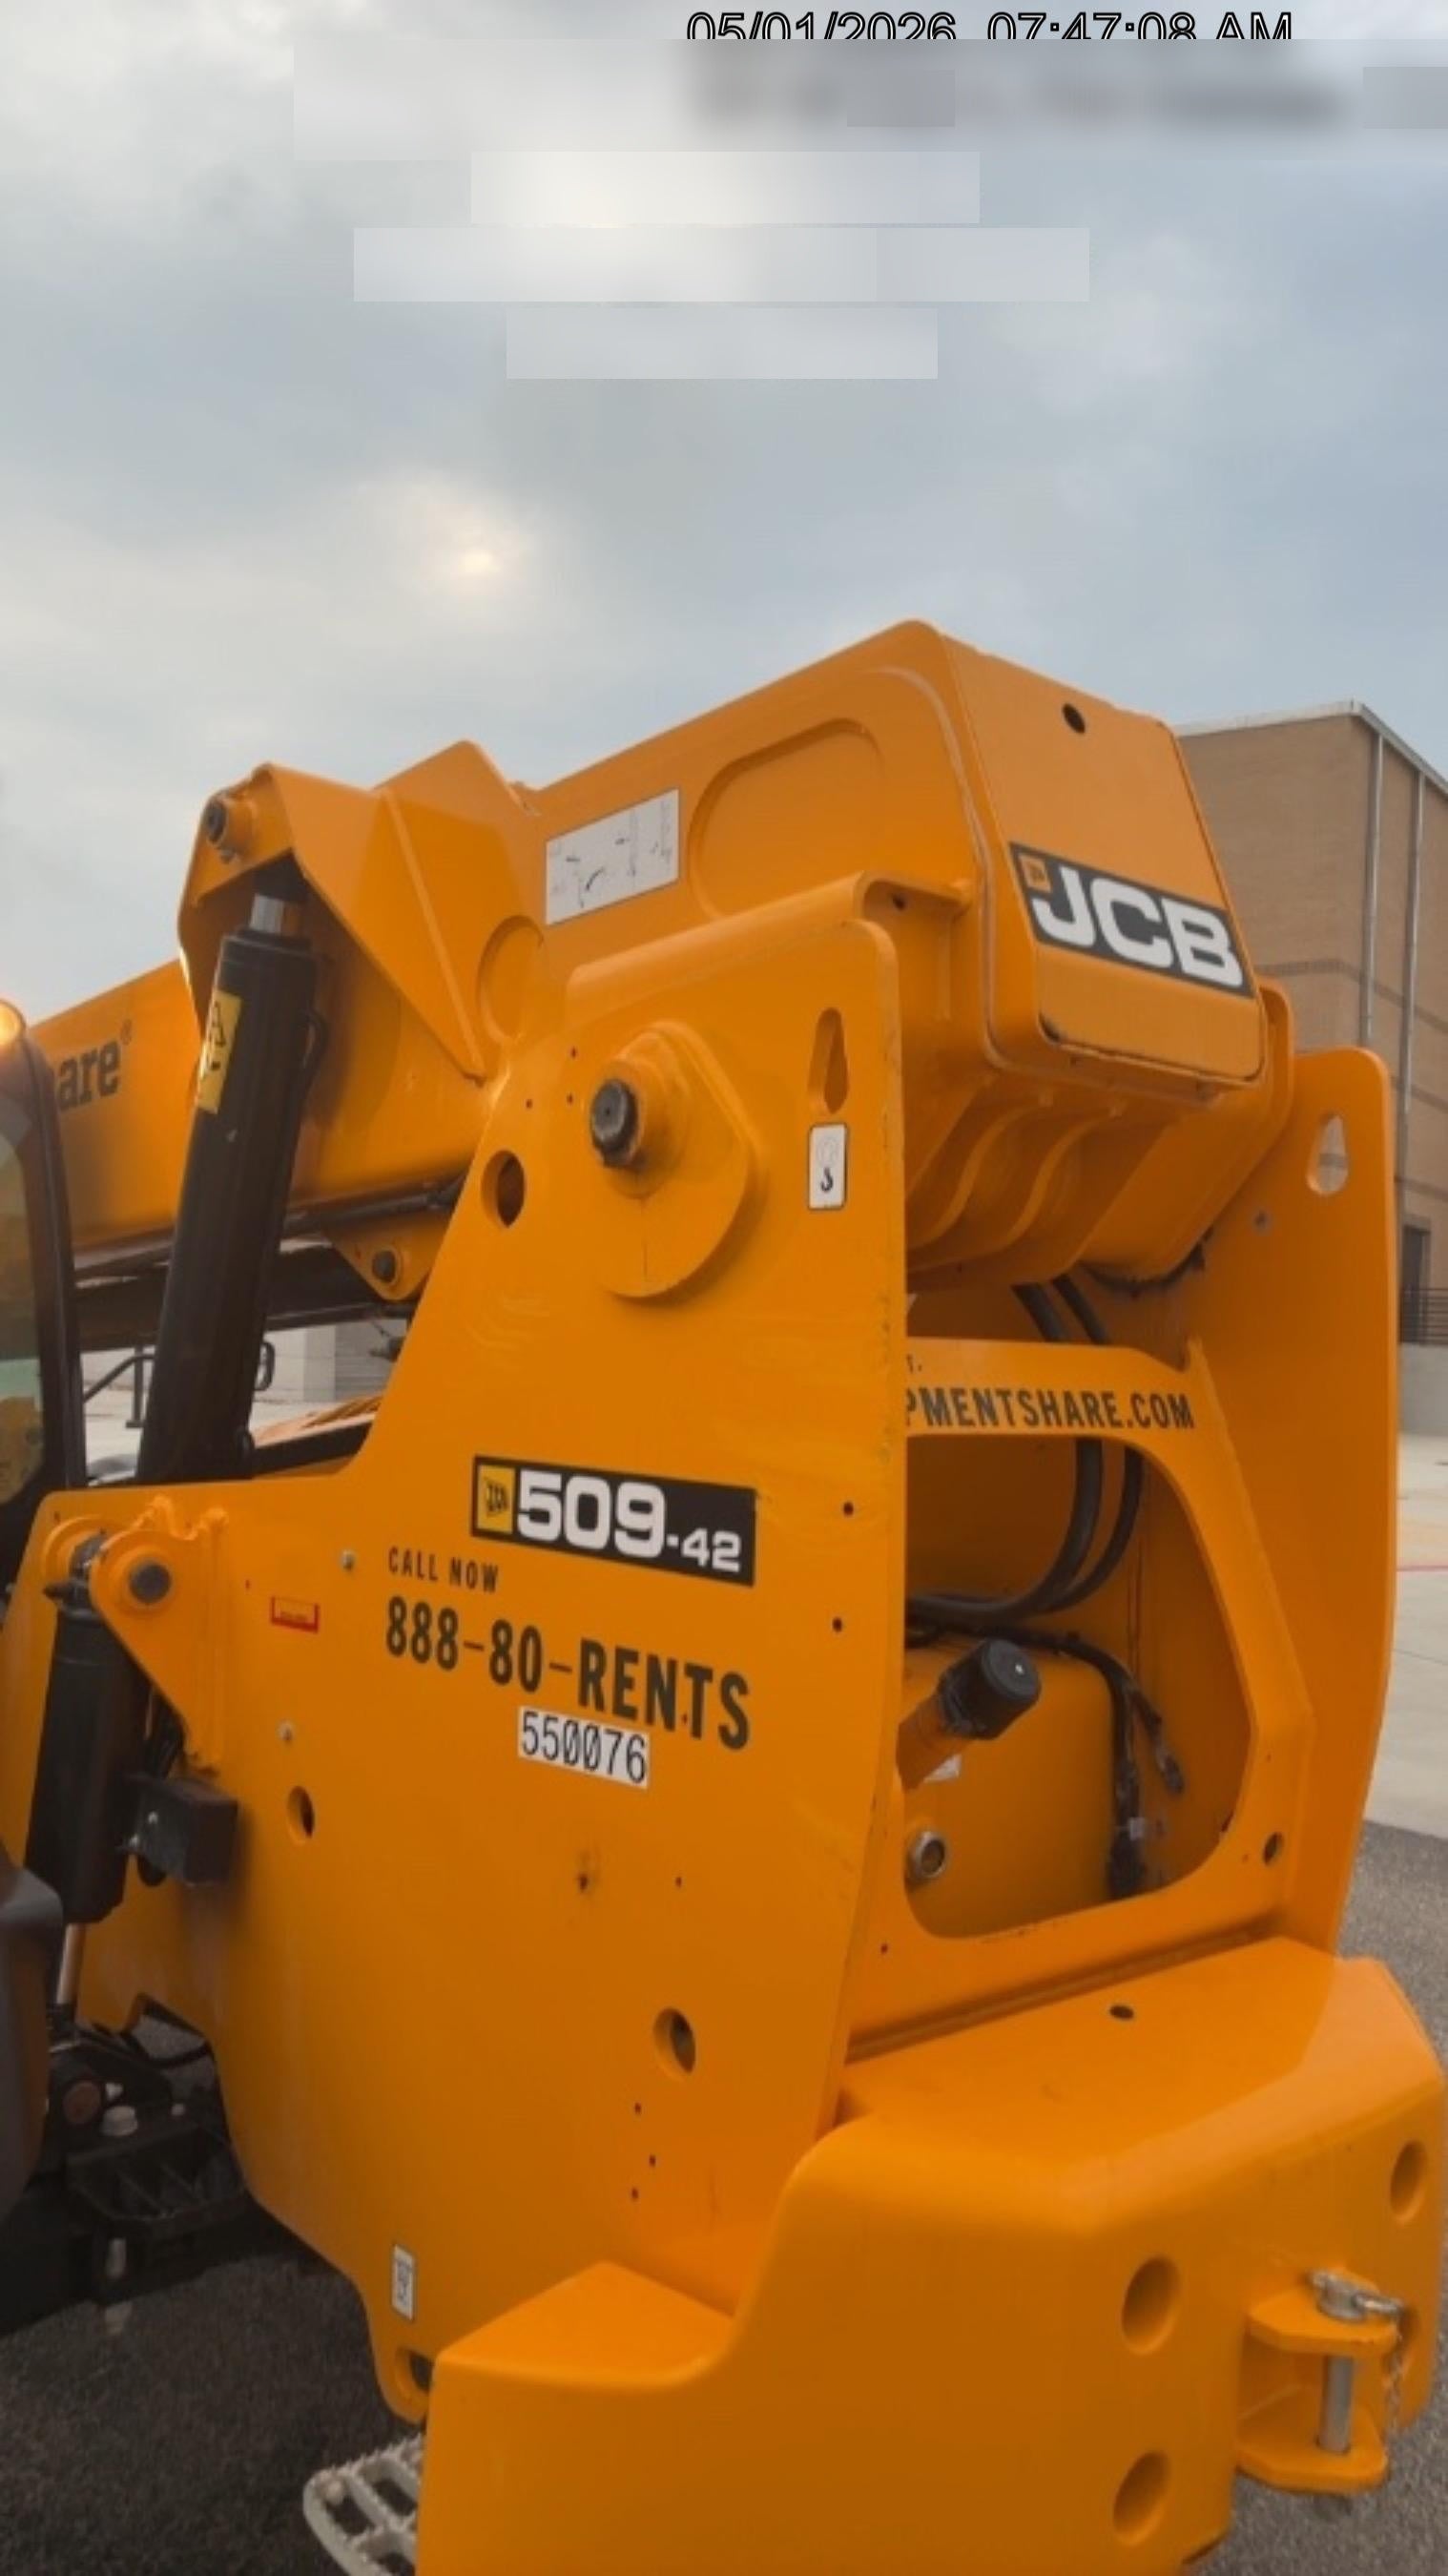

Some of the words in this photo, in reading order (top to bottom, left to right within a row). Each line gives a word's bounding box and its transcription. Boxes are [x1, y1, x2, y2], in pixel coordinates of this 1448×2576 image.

[1030, 864, 1244, 988] JCB
[388, 1546, 439, 1583] CALL
[448, 1556, 500, 1593] NOW
[516, 1467, 742, 1573] 509-42
[385, 1595, 752, 1752] 888-80-RENTS
[521, 1710, 649, 1785] 550076
